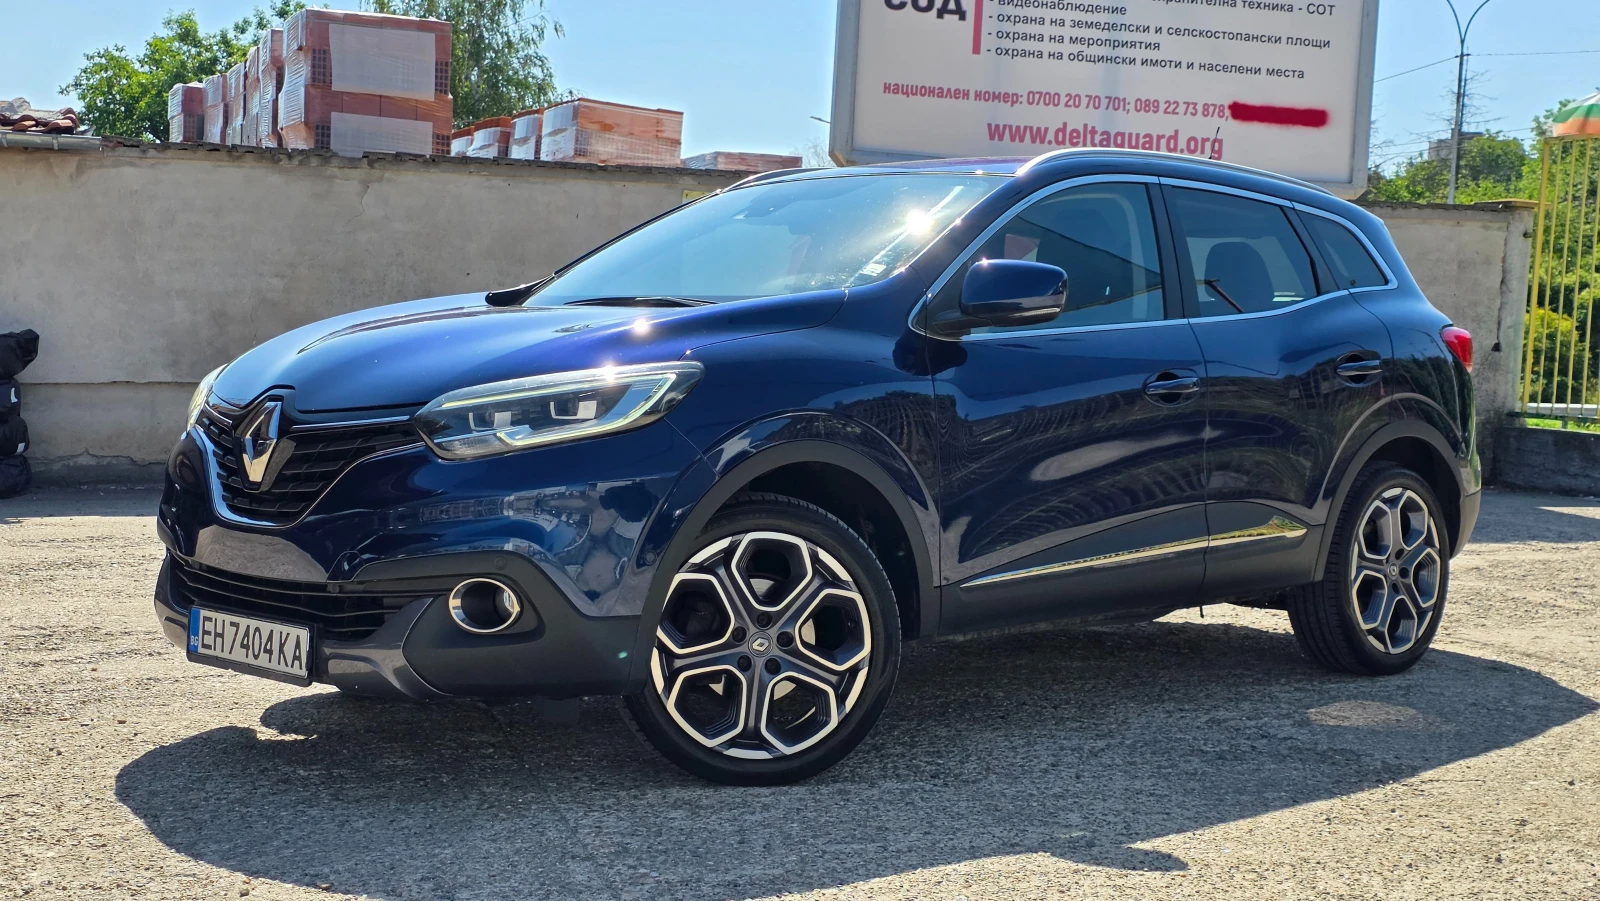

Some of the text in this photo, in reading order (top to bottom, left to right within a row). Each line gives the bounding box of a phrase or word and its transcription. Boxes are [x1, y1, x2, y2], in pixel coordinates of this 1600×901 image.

[1241, 0, 1294, 13] техника
[1306, 3, 1336, 16] СОТ
[996, 30, 1044, 44] охрана
[1049, 34, 1065, 45] на
[1069, 36, 1161, 51] мероприятия
[997, 13, 1045, 27] охрана
[1050, 17, 1066, 28] на
[1069, 18, 1150, 35] земеделски
[1154, 25, 1163, 35] и
[1167, 26, 1282, 45] селскостопански
[1286, 36, 1331, 49] площи
[995, 46, 1043, 60] охрана
[1048, 50, 1063, 61] на
[1068, 49, 1136, 66] общински
[1141, 58, 1182, 70] имоти
[1186, 61, 1194, 70] и
[1199, 61, 1261, 76] населени
[1266, 67, 1305, 79] места
[883, 82, 1229, 121] национален номер: 0700 20 70 701; 089 22 73 878,
[987, 121, 1223, 161] www.deltaguard.org
[190, 635, 199, 646] BG
